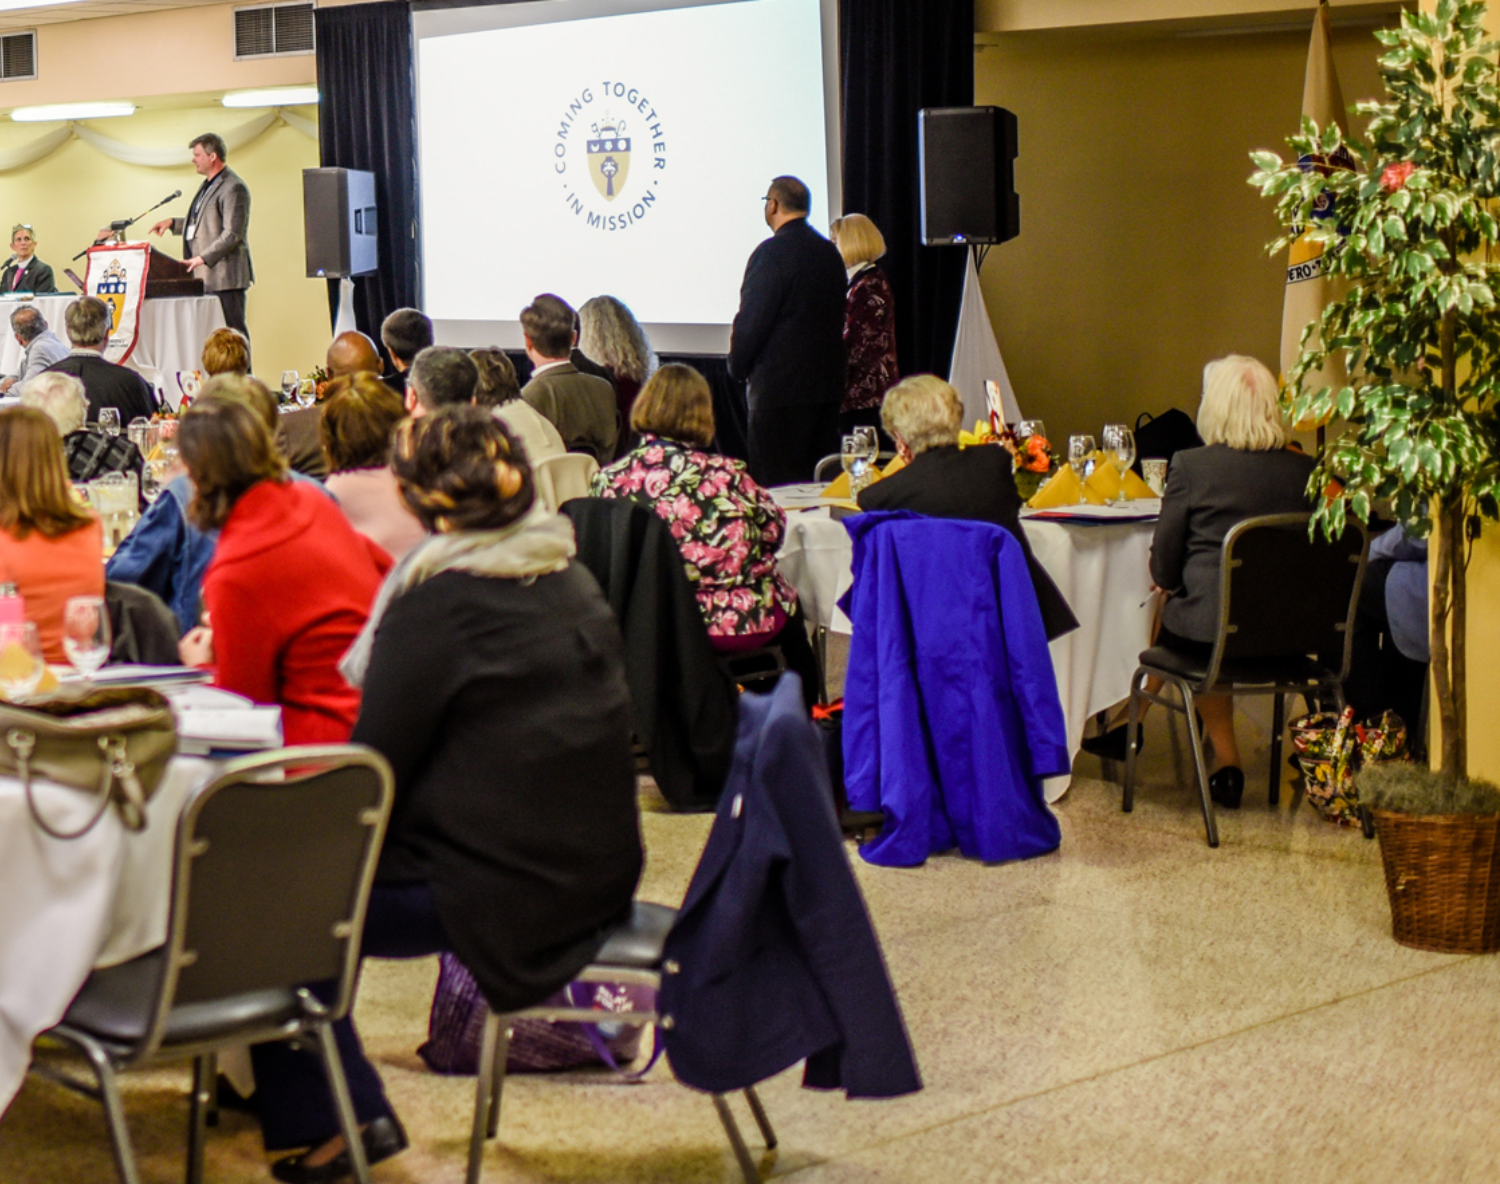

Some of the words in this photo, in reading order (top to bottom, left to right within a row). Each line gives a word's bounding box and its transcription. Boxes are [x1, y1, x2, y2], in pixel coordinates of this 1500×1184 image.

[554, 88, 594, 174] COMING
[602, 81, 666, 170] TOGETHER
[566, 192, 584, 215] IN
[587, 190, 656, 231] MISSION
[1287, 263, 1312, 281] ERO
